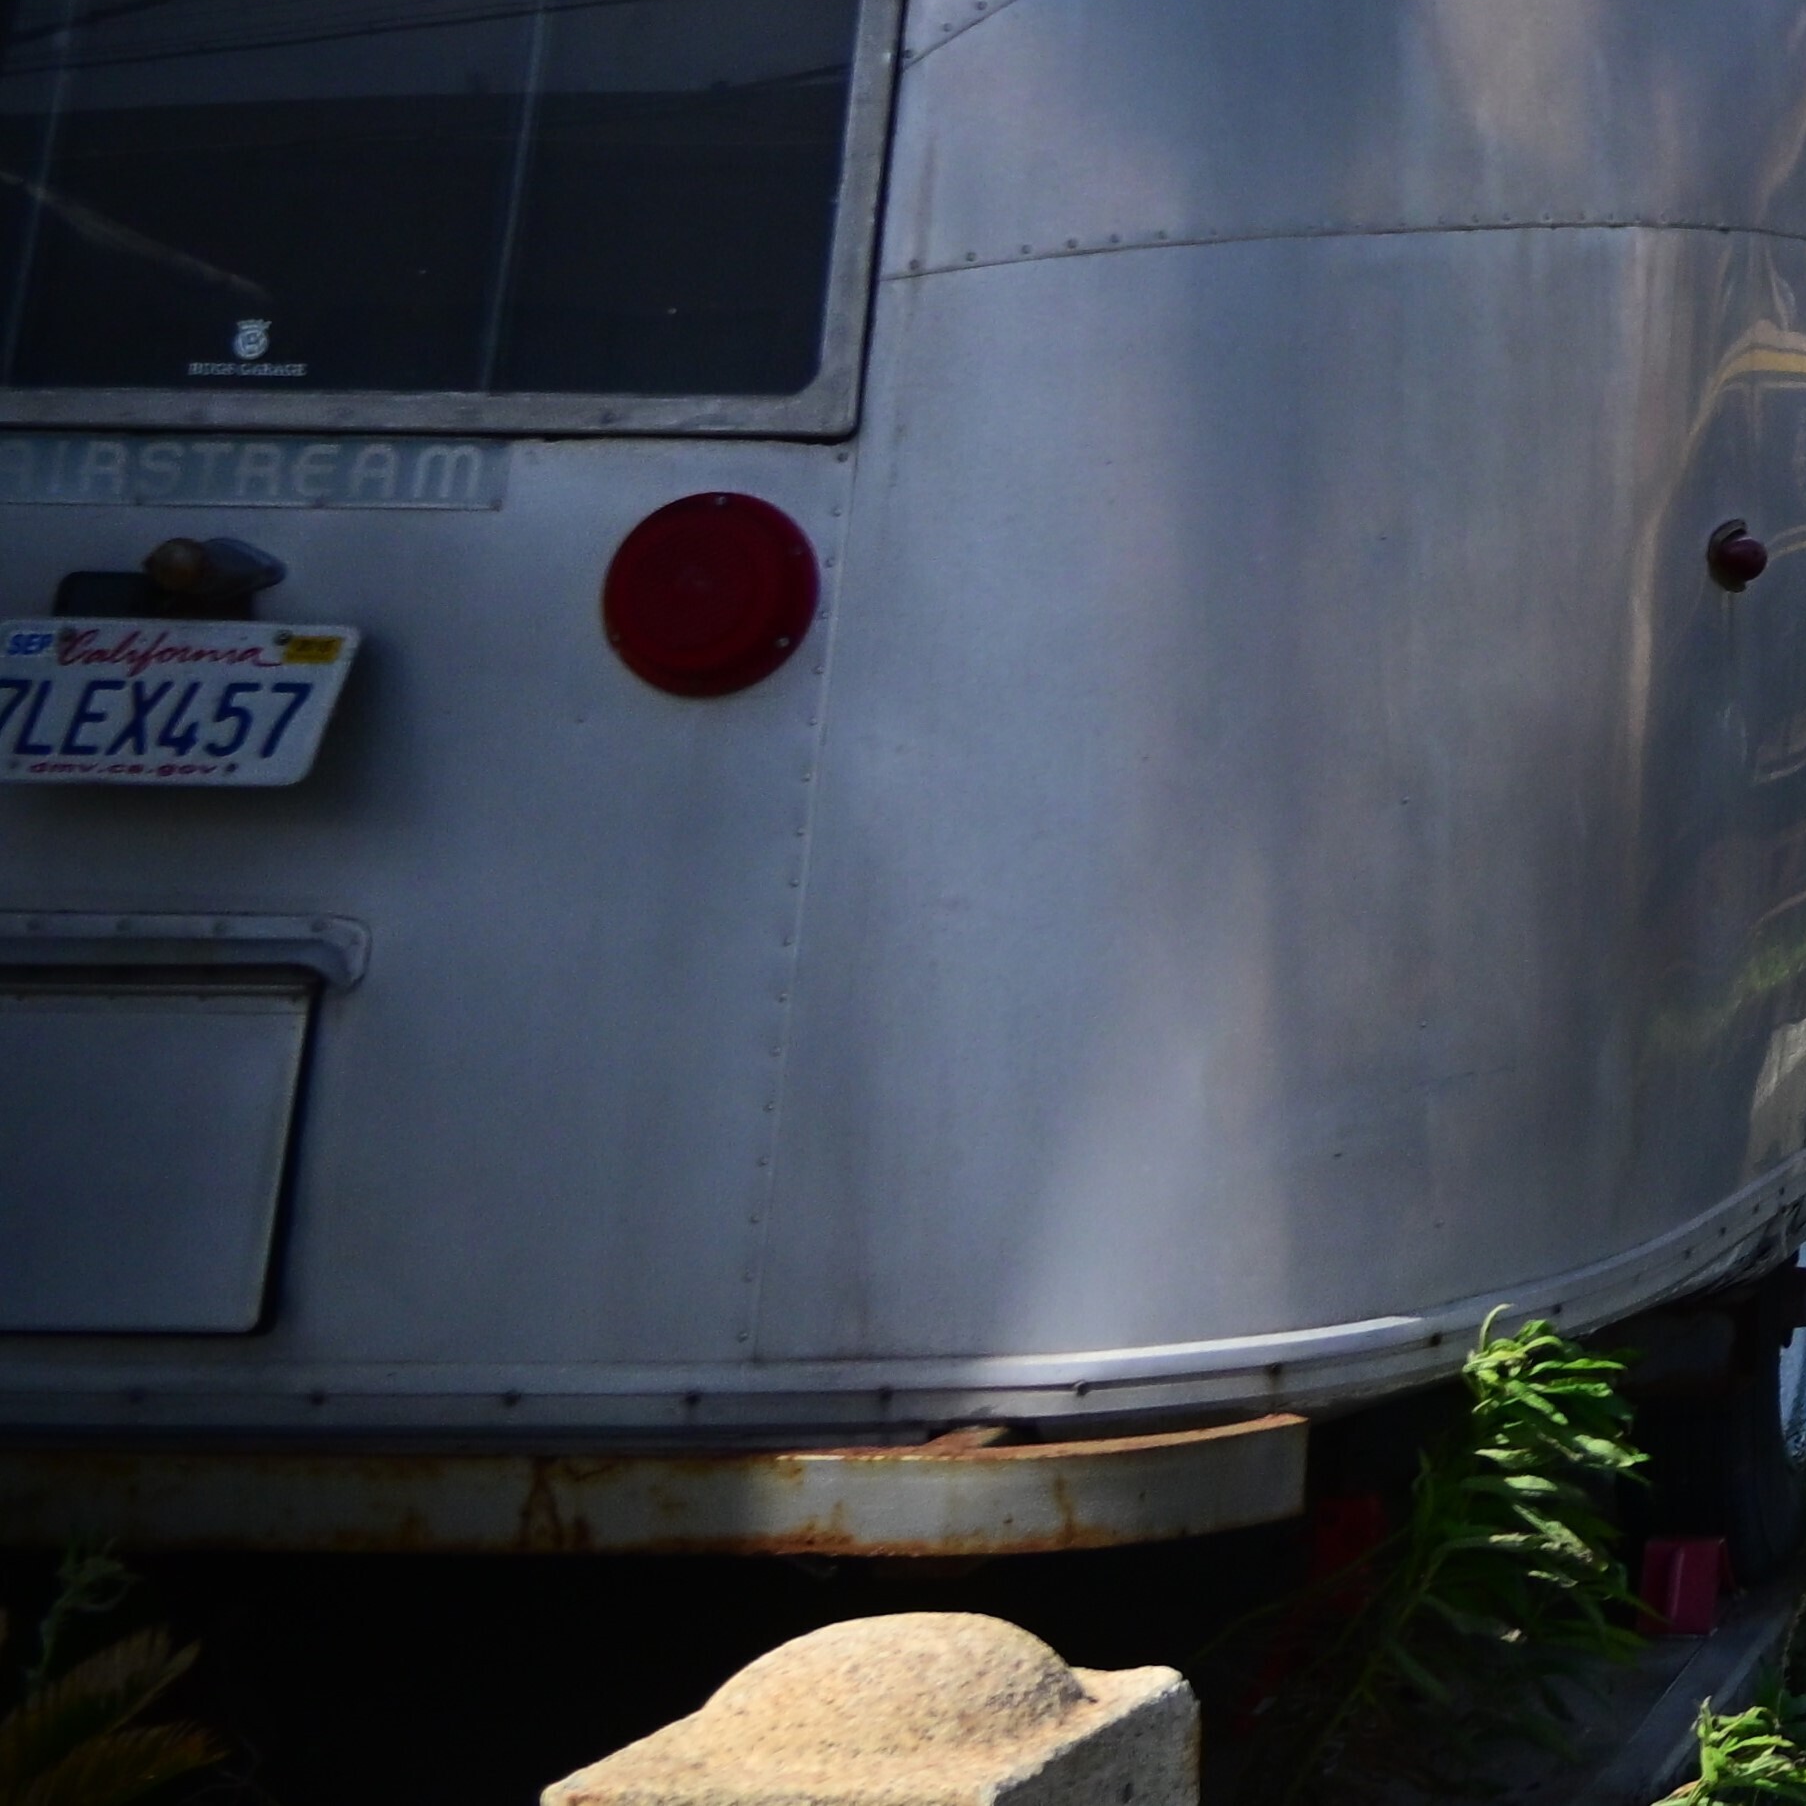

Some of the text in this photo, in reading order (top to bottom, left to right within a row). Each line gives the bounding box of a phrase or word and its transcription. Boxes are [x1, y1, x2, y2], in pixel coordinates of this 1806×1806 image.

[57, 628, 284, 678] California
[0, 678, 314, 759] 7LEX457
[28, 762, 219, 778] dmv.ca.gov
